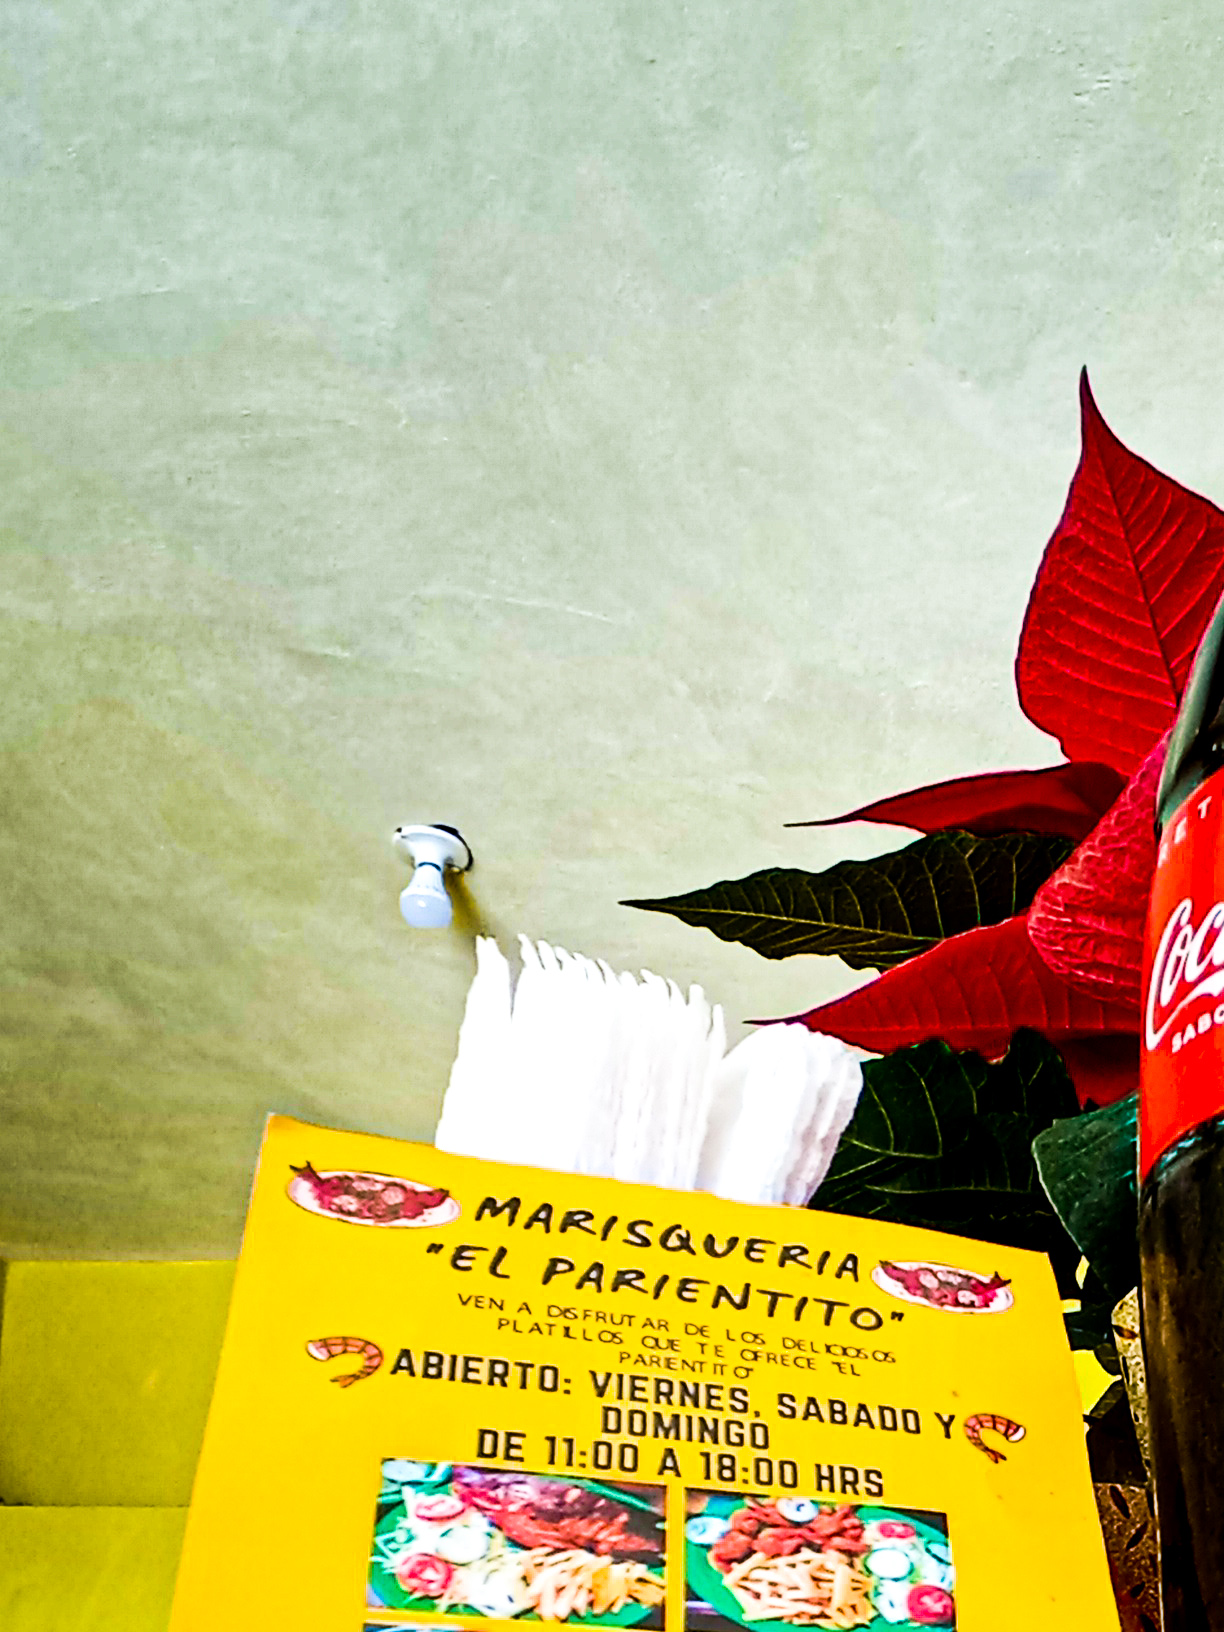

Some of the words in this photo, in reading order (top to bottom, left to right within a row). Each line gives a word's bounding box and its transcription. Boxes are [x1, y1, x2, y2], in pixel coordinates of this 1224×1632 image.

[475, 1196, 859, 1282] MARISQUERIA
[457, 1293, 504, 1311] VEN
[517, 1302, 532, 1315] A
[547, 1304, 669, 1332] DISFRUTAR
[684, 1322, 711, 1338] DE
[726, 1329, 766, 1346] LOS
[542, 1256, 904, 1331] PARIENTITO"
[497, 1317, 623, 1345] PLATILLOS
[641, 1335, 681, 1352] QUE
[697, 1342, 725, 1358] TE
[740, 1348, 817, 1371] OFRECE
[390, 1348, 571, 1395] ABIERTO:
[589, 1370, 760, 1418] VIERNES,
[777, 1393, 921, 1435] SABADO
[934, 1411, 955, 1439] Y
[601, 1405, 769, 1450] DOMINGO
[476, 1428, 526, 1463] DE
[544, 1436, 639, 1473] 11:00
[657, 1447, 681, 1478] A
[699, 1451, 798, 1489] 18:00
[814, 1463, 883, 1498] HRS
